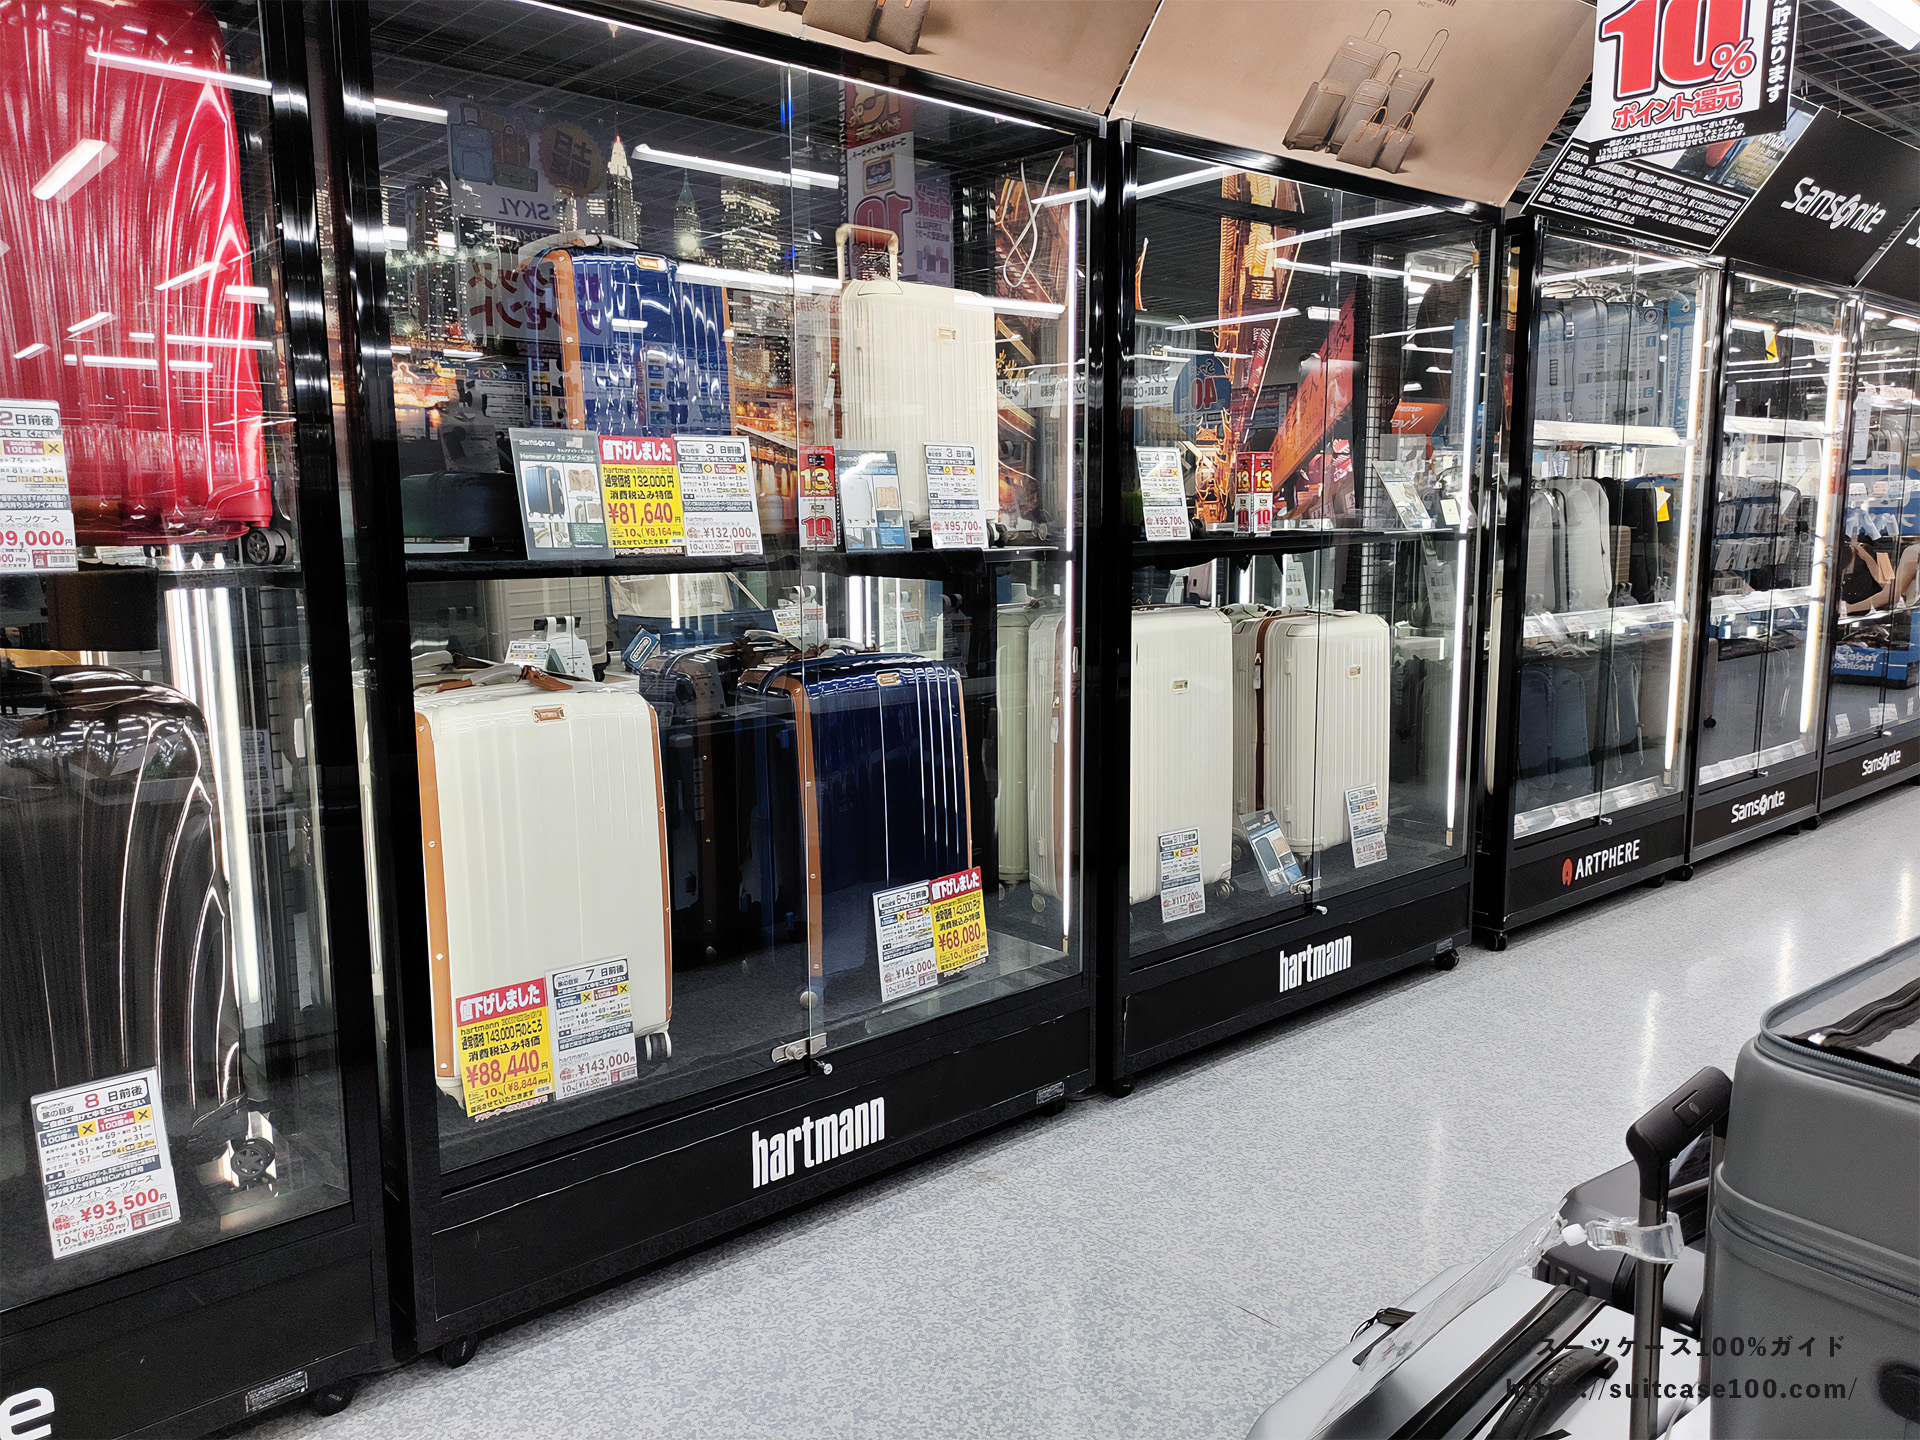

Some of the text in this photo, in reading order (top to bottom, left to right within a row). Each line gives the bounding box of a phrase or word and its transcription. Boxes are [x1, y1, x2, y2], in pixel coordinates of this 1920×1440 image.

[1766, 0, 1792, 103] 貯まります
[1612, 80, 1743, 131] ポイント還元
[1781, 177, 1886, 234] Samsonite
[16, 414, 54, 427] 日前後
[603, 439, 672, 462] 値下げしました
[706, 444, 715, 454] 3
[720, 446, 742, 454] 日前後
[946, 448, 953, 458] 3
[603, 466, 636, 474] hartmann
[800, 468, 833, 490] 13%
[604, 474, 674, 489] 通常価格 132,000円
[610, 490, 673, 500] 消費税込み特価
[6, 515, 59, 524] スーツケース
[1862, 749, 1901, 777] Samsonite
[1731, 790, 1785, 823] Samsonite
[1574, 839, 1641, 881] ARTPHERE
[932, 872, 979, 899] 値下げしました
[940, 912, 980, 931] 消費税込み特価
[586, 969, 595, 981] 7
[601, 965, 624, 977] 日前後
[1280, 935, 1352, 993] hartmann
[460, 984, 540, 1021] 値下げしました
[461, 1021, 499, 1036] hartmann
[462, 1034, 484, 1050] 通常価格
[487, 1019, 543, 1044] 143,000円のところ
[468, 1036, 541, 1062] 消費税込み特価
[559, 1051, 589, 1064] hartmann
[42, 1085, 143, 1120] 旅の目安 8 日前後
[105, 1131, 116, 1139] 69
[132, 1124, 142, 1132] 31
[107, 1140, 117, 1148] 75
[134, 1133, 144, 1141] 31
[752, 1097, 885, 1189] hartmann
[74, 1156, 91, 1165] 157
[51, 1174, 153, 1210] サムソナイト スーツケース
